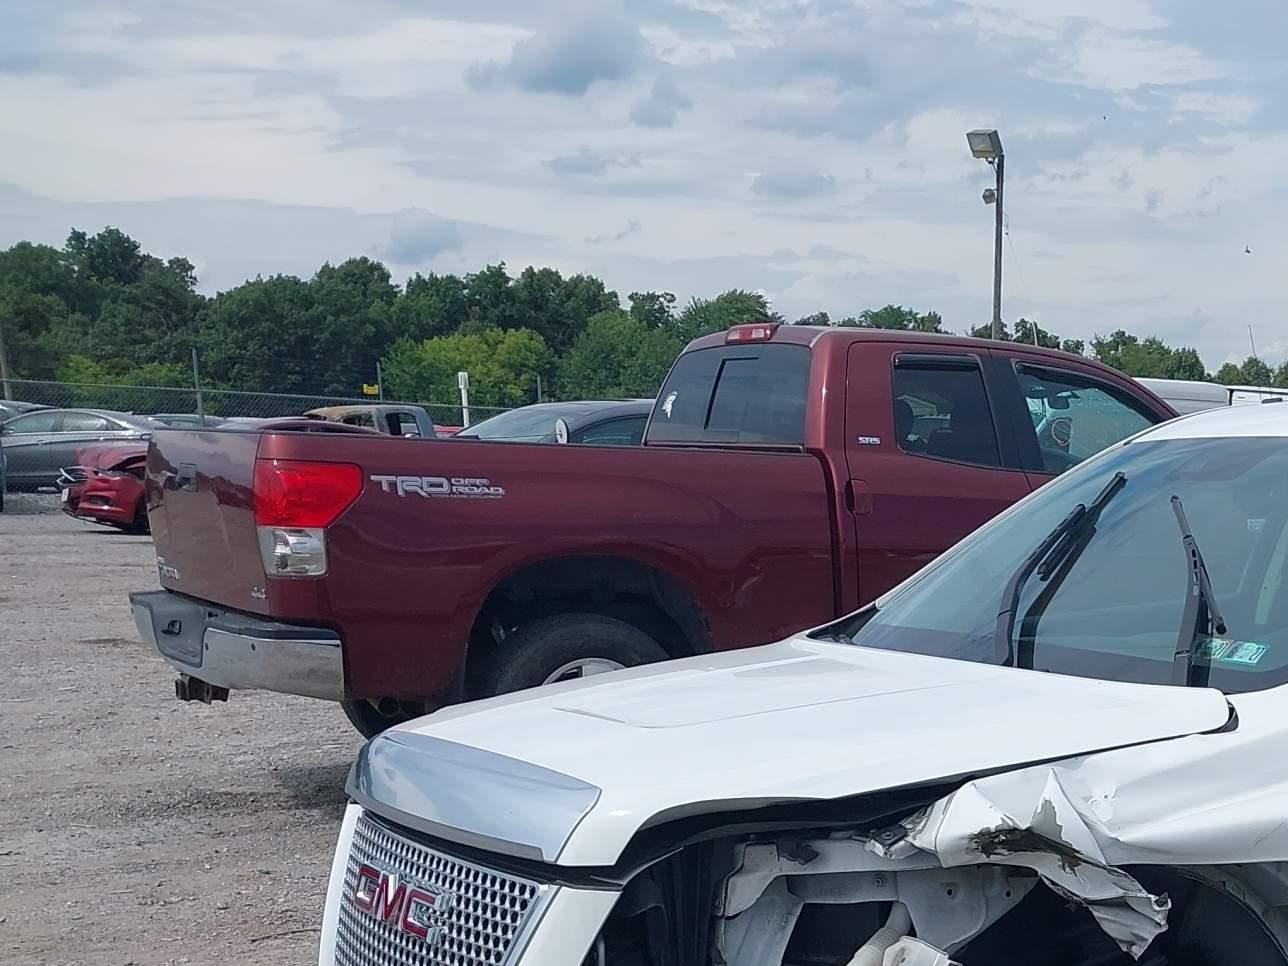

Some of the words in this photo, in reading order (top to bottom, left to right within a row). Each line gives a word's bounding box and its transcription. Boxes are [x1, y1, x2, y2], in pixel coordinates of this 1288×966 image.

[857, 435, 881, 446] SR5
[369, 474, 451, 498] TRD
[451, 477, 490, 487] OFF
[451, 485, 505, 496] ROAD
[353, 860, 446, 944] GMC
